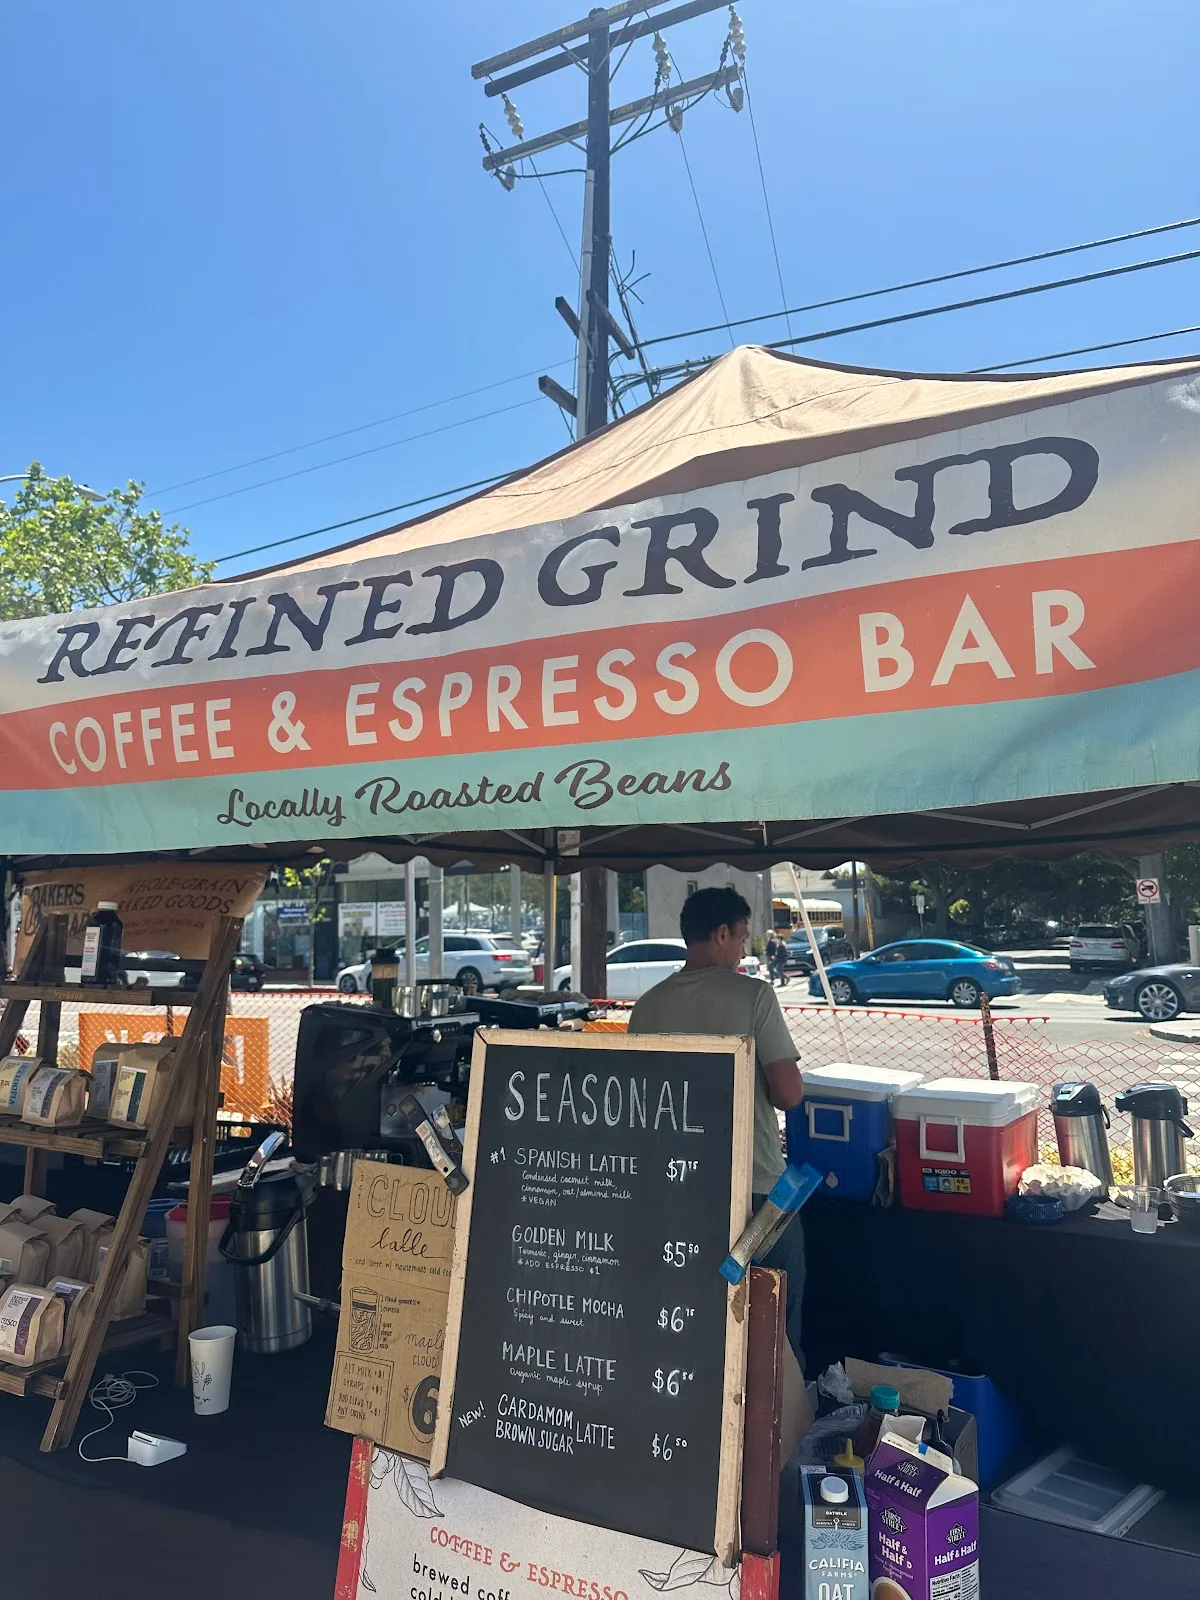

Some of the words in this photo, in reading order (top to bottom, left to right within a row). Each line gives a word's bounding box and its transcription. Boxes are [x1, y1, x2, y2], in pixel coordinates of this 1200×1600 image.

[37, 558, 504, 683] REFINED
[537, 436, 1099, 606] GRIND
[50, 697, 235, 775] COFFEE
[267, 690, 311, 754] &
[346, 628, 794, 747] ESPRESSO
[859, 589, 1096, 693] BAR
[217, 786, 346, 827] Locally
[355, 771, 544, 815] Roasted
[554, 758, 733, 809] Beans
[165, 894, 235, 915] GOODS
[504, 1070, 705, 1133] SEASONAL
[490, 1146, 506, 1165] #1
[514, 1148, 581, 1170] SPANISH
[589, 1153, 638, 1175] LATTE
[522, 1170, 558, 1183] Condensed
[560, 1174, 589, 1185] coconut
[612, 1189, 632, 1199] milk
[512, 1224, 566, 1247] GOLDEN
[575, 1230, 615, 1252] MILK
[545, 1262, 585, 1273] ESPRESSO
[582, 1254, 621, 1267] cinnamon
[442, 1268, 452, 1277] foa
[506, 1287, 575, 1311] CHIPOTLE
[582, 1297, 625, 1319] MOCHA
[513, 1308, 534, 1326] Spicy
[540, 1312, 555, 1324] and
[560, 1317, 585, 1327] sweet
[405, 1329, 445, 1354] maple
[344, 1362, 356, 1375] ALT
[357, 1365, 372, 1378] MILK
[412, 1354, 438, 1369] CLOUD
[502, 1341, 556, 1370] MAPLE
[564, 1352, 617, 1381] LATTE
[343, 1379, 364, 1391] SYRUPS
[509, 1367, 541, 1383] Organic
[546, 1374, 572, 1387] maple
[576, 1381, 603, 1397] syrup
[349, 1395, 364, 1408] CLOUD
[366, 1400, 373, 1409] TO
[498, 1393, 574, 1430] CARDAMOM
[458, 1400, 487, 1428] NEW!
[495, 1419, 536, 1446] BROWN
[537, 1430, 575, 1455] SUGAR
[576, 1420, 616, 1450] LATTE
[902, 1461, 918, 1472] FIRST
[874, 1469, 897, 1485] Half
[894, 1479, 900, 1487] &
[900, 1481, 923, 1498] Half
[881, 1514, 904, 1533] STREET
[884, 1508, 902, 1522] FIRST
[947, 1532, 966, 1544] STREET
[949, 1525, 963, 1537] FIRST
[878, 1531, 901, 1552] Half
[901, 1545, 908, 1556] &
[934, 1549, 955, 1566] Half
[954, 1549, 960, 1558] &
[960, 1540, 977, 1556] Half
[430, 1526, 493, 1566] COFFEE
[499, 1551, 521, 1573] &
[527, 1562, 629, 1600] ESPRESSO
[808, 1557, 865, 1573] CALIFIA
[881, 1545, 904, 1566] Half
[413, 1552, 470, 1595] brewed
[478, 1588, 510, 1600] coff
[821, 1571, 853, 1579] FARMS
[931, 1577, 950, 1586] Nutrition
[818, 1582, 855, 1600] OAT
